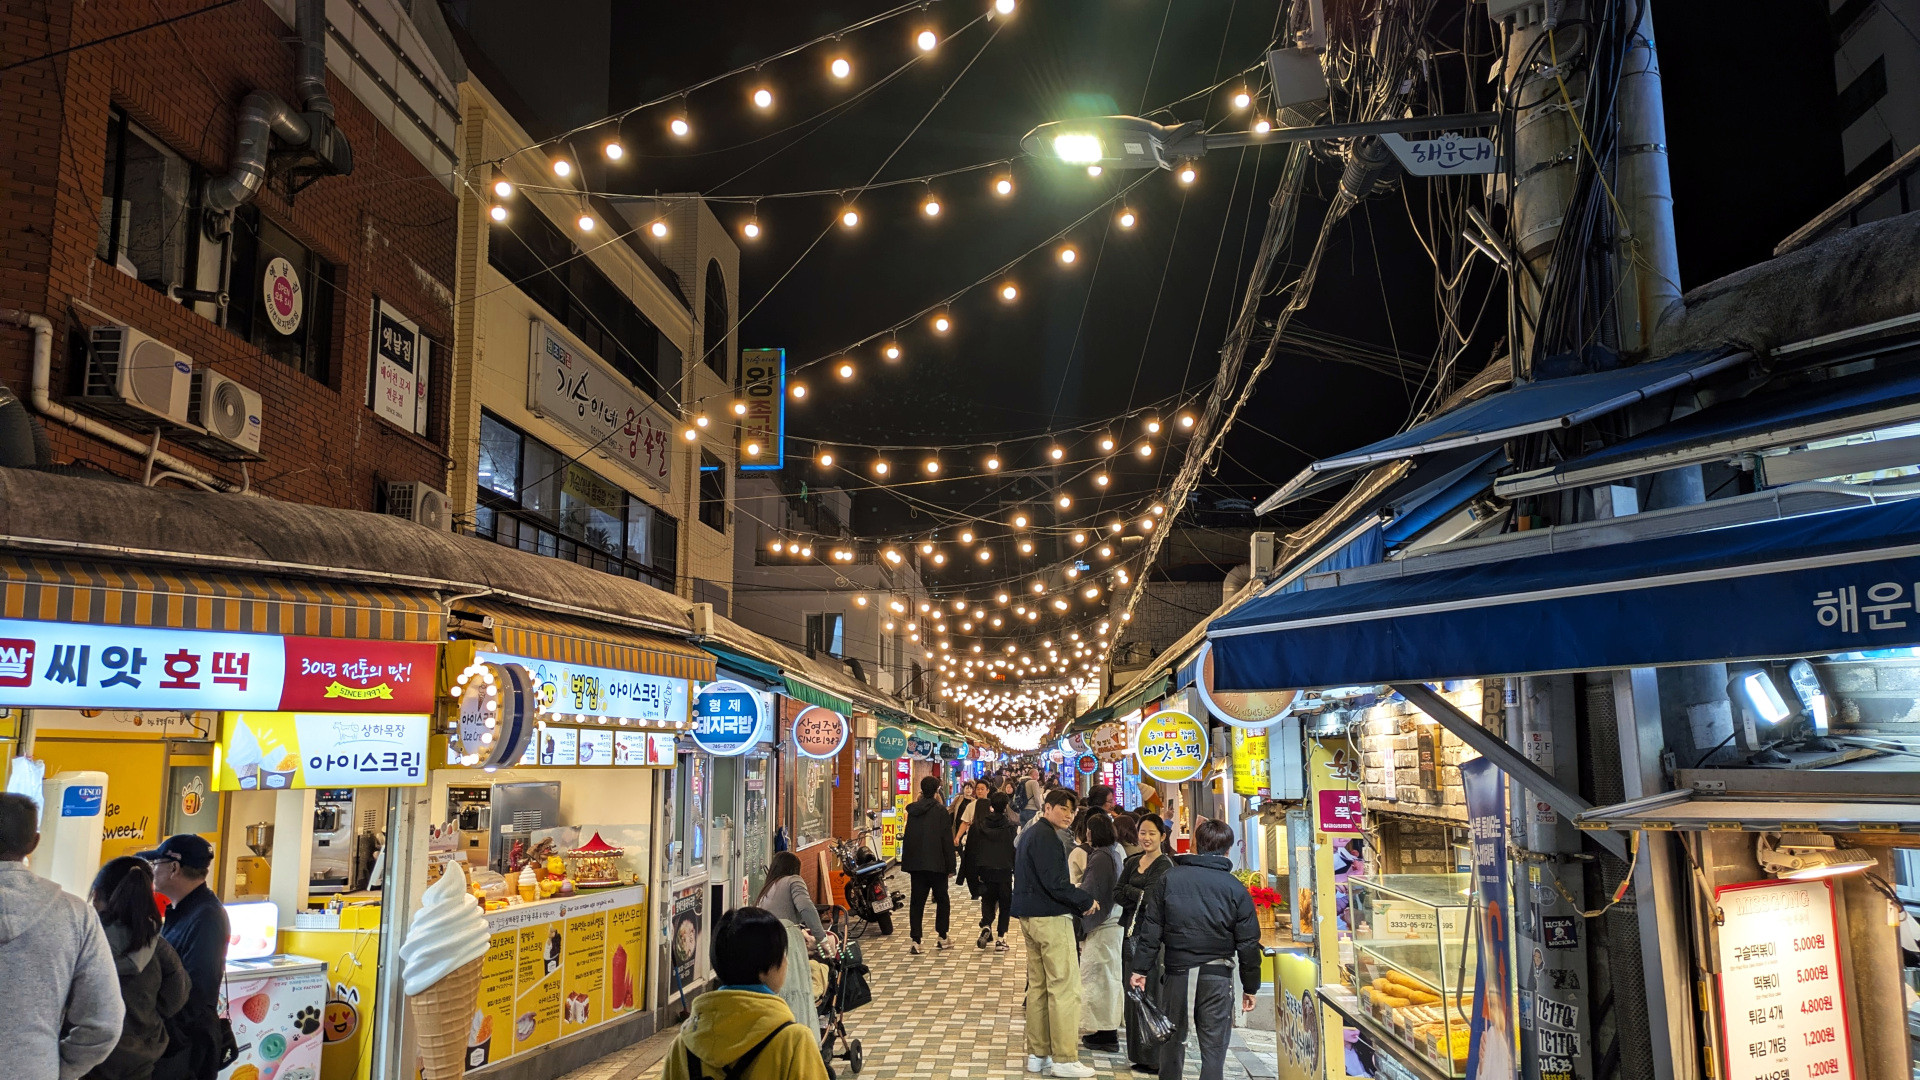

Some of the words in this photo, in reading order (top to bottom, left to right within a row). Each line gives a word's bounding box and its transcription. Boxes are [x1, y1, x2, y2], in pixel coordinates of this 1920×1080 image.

[1411, 142, 1491, 167] 해운대
[383, 327, 411, 362] 옛날집
[557, 368, 618, 428] 기승이네
[624, 407, 667, 478] 왕족발
[1813, 582, 1920, 633] 해운
[44, 645, 147, 689] 씨앗
[159, 649, 250, 691] 호떡
[302, 658, 337, 678] 30년
[342, 658, 382, 685] 전통의
[388, 663, 412, 683] 맛!
[340, 687, 362, 698] SINCE
[363, 688, 381, 698] 1997
[609, 682, 660, 709] 아이스크림
[361, 724, 406, 737] 상하목장
[463, 731, 473, 742] Ice
[695, 715, 754, 735] 돼지국밥
[798, 717, 842, 735] 삼영주방
[798, 735, 821, 744] SINCE
[879, 736, 904, 746] CAFE
[310, 752, 420, 777] 아이스크림
[1143, 743, 1202, 762] 씨앗호떡
[897, 761, 909, 791] 족발
[896, 798, 904, 832] 돼지국밥
[881, 823, 895, 834] 지
[881, 835, 895, 846] 밥
[1545, 920, 1573, 929] ЦСКА
[488, 949, 515, 962] 아이스크림
[1734, 941, 1777, 962] 구슬떡볶이
[1793, 934, 1825, 952] 5,000원
[1753, 973, 1780, 991] 떡볶이
[1797, 964, 1829, 983] 5,000원
[1748, 1008, 1767, 1025] 튀김
[1769, 1004, 1784, 1020] 4개
[1800, 995, 1833, 1014] 4,800원
[1749, 1041, 1767, 1058] 튀김
[1768, 1036, 1787, 1054] 개당
[1803, 1026, 1836, 1046] 1,200원
[1806, 1058, 1840, 1079] 1,200원
